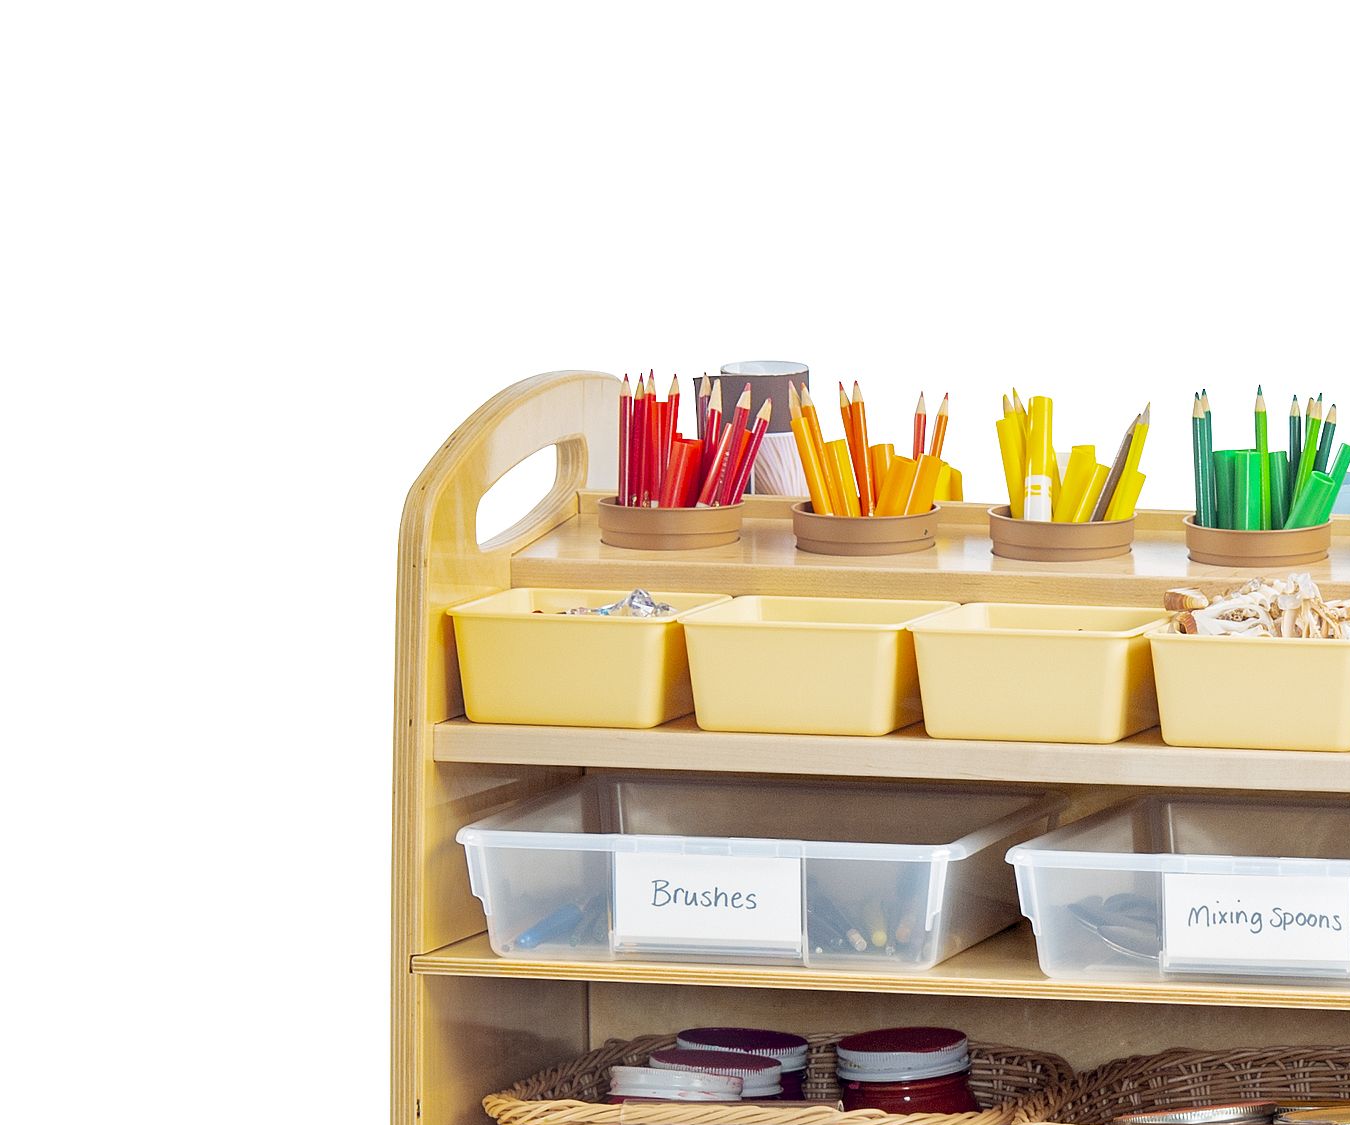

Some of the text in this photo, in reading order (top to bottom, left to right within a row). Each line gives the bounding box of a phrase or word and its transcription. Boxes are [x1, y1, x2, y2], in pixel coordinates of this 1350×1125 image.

[651, 879, 757, 910] Brushes
[1188, 899, 1342, 934] Mixing Spoons
